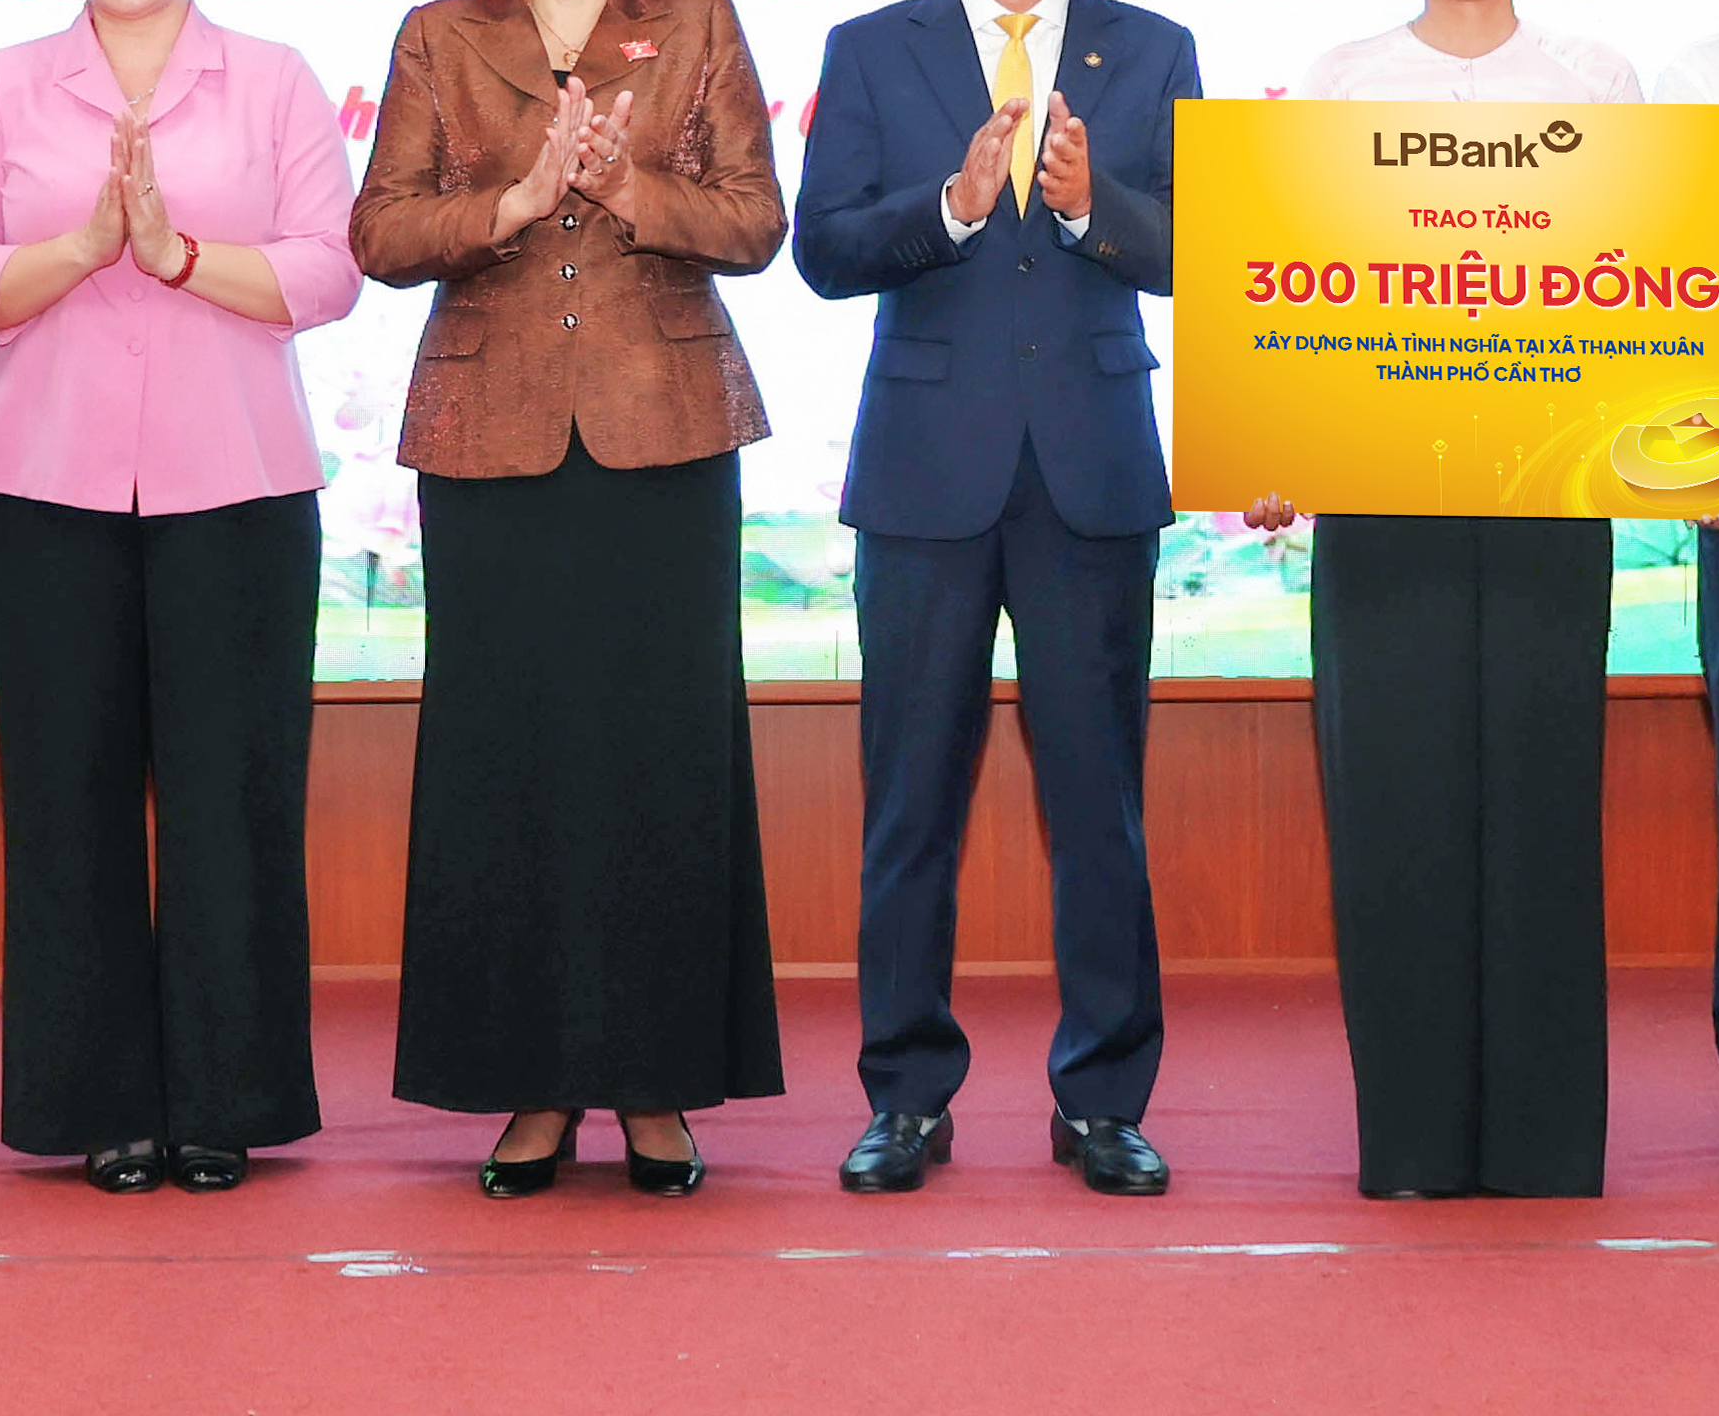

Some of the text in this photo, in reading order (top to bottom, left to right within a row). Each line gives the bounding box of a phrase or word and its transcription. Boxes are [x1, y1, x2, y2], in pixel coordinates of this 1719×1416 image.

[1373, 131, 1539, 168] LPBank
[1409, 203, 1551, 233] TRAO TẶNG
[1244, 248, 1719, 317] 300 TRIỆU ĐỒNG
[1254, 331, 1704, 359] XÂY DỰNG NHÀ TÌNH NGHĨA TẠI XÃ THẠNH XUÂN
[1376, 361, 1581, 383] THÀNH PHỐ CẦN THƠ
